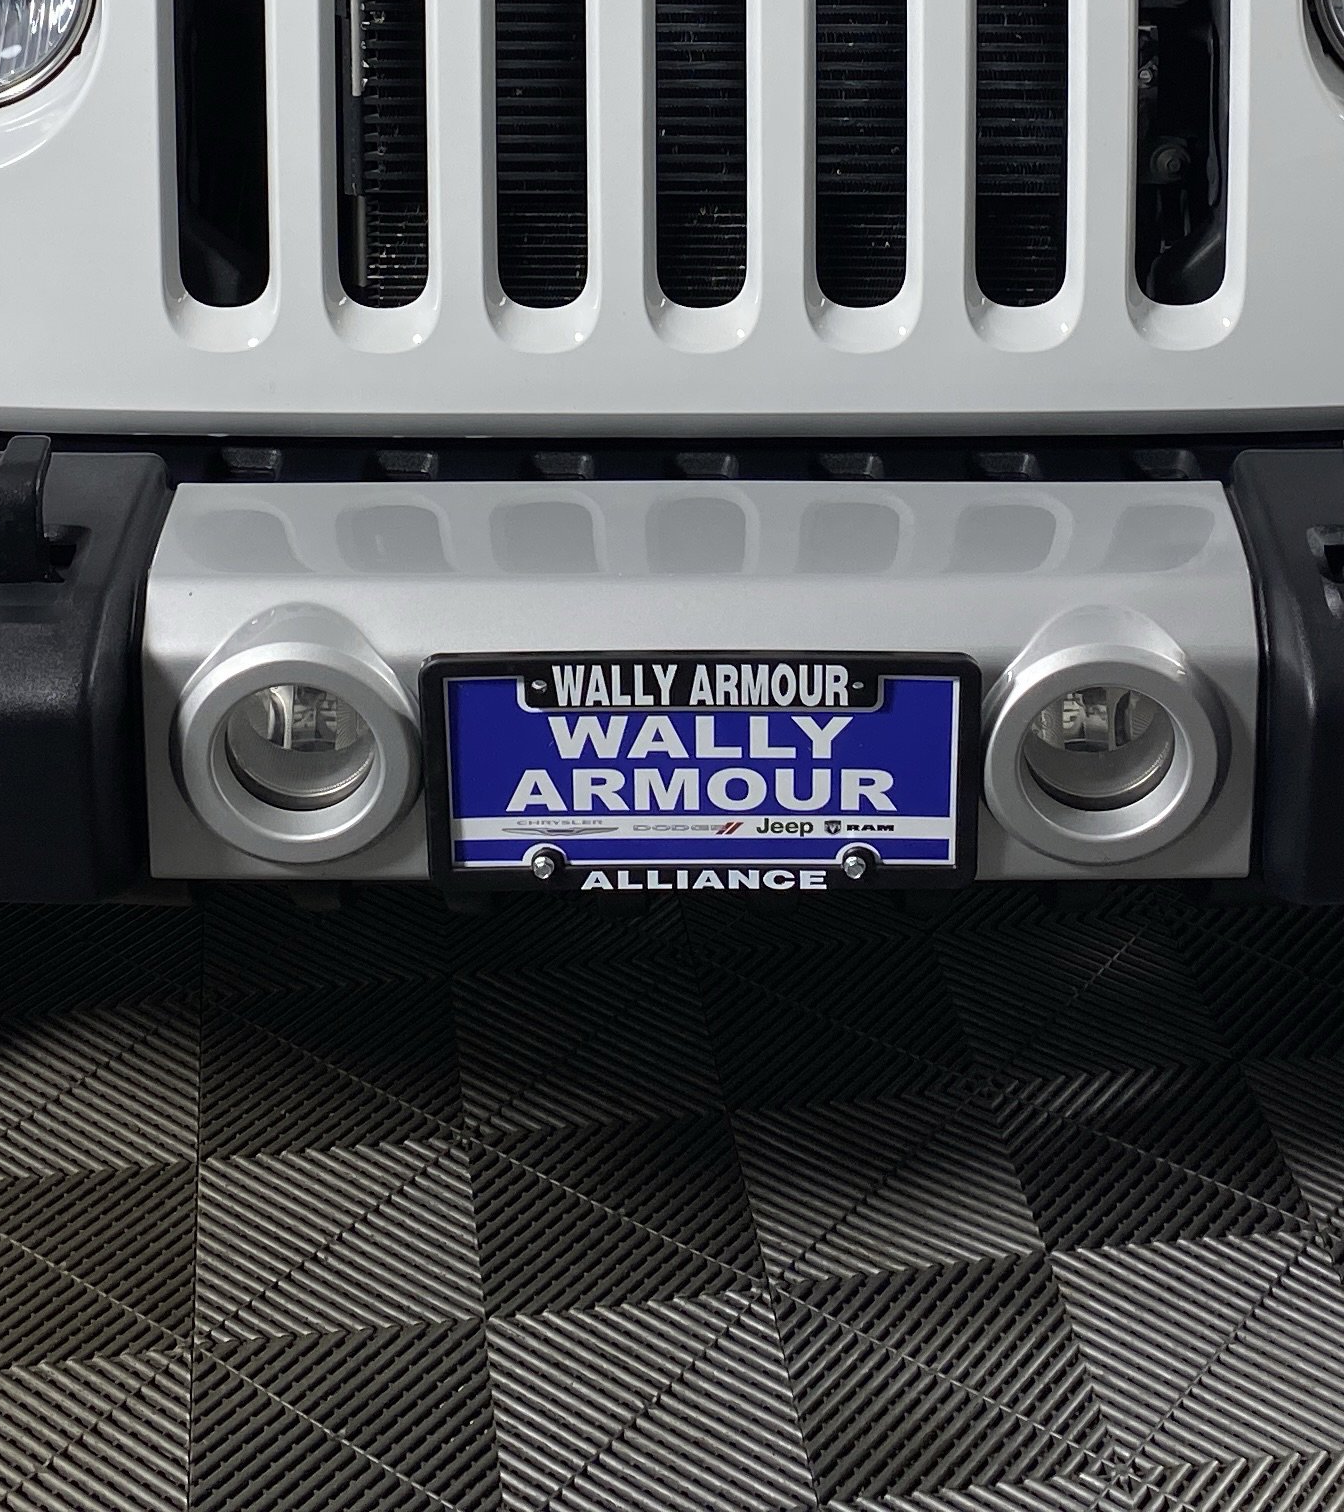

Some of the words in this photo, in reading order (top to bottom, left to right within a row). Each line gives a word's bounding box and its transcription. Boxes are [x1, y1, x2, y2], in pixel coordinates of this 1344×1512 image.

[552, 664, 678, 706] WALLY
[689, 663, 849, 706] ARMOUR
[548, 715, 854, 759] WALLY
[506, 768, 898, 812] ARMOUR
[756, 818, 814, 837] Jeep
[846, 824, 895, 832] RAM
[580, 870, 827, 890] ALLIANCE
